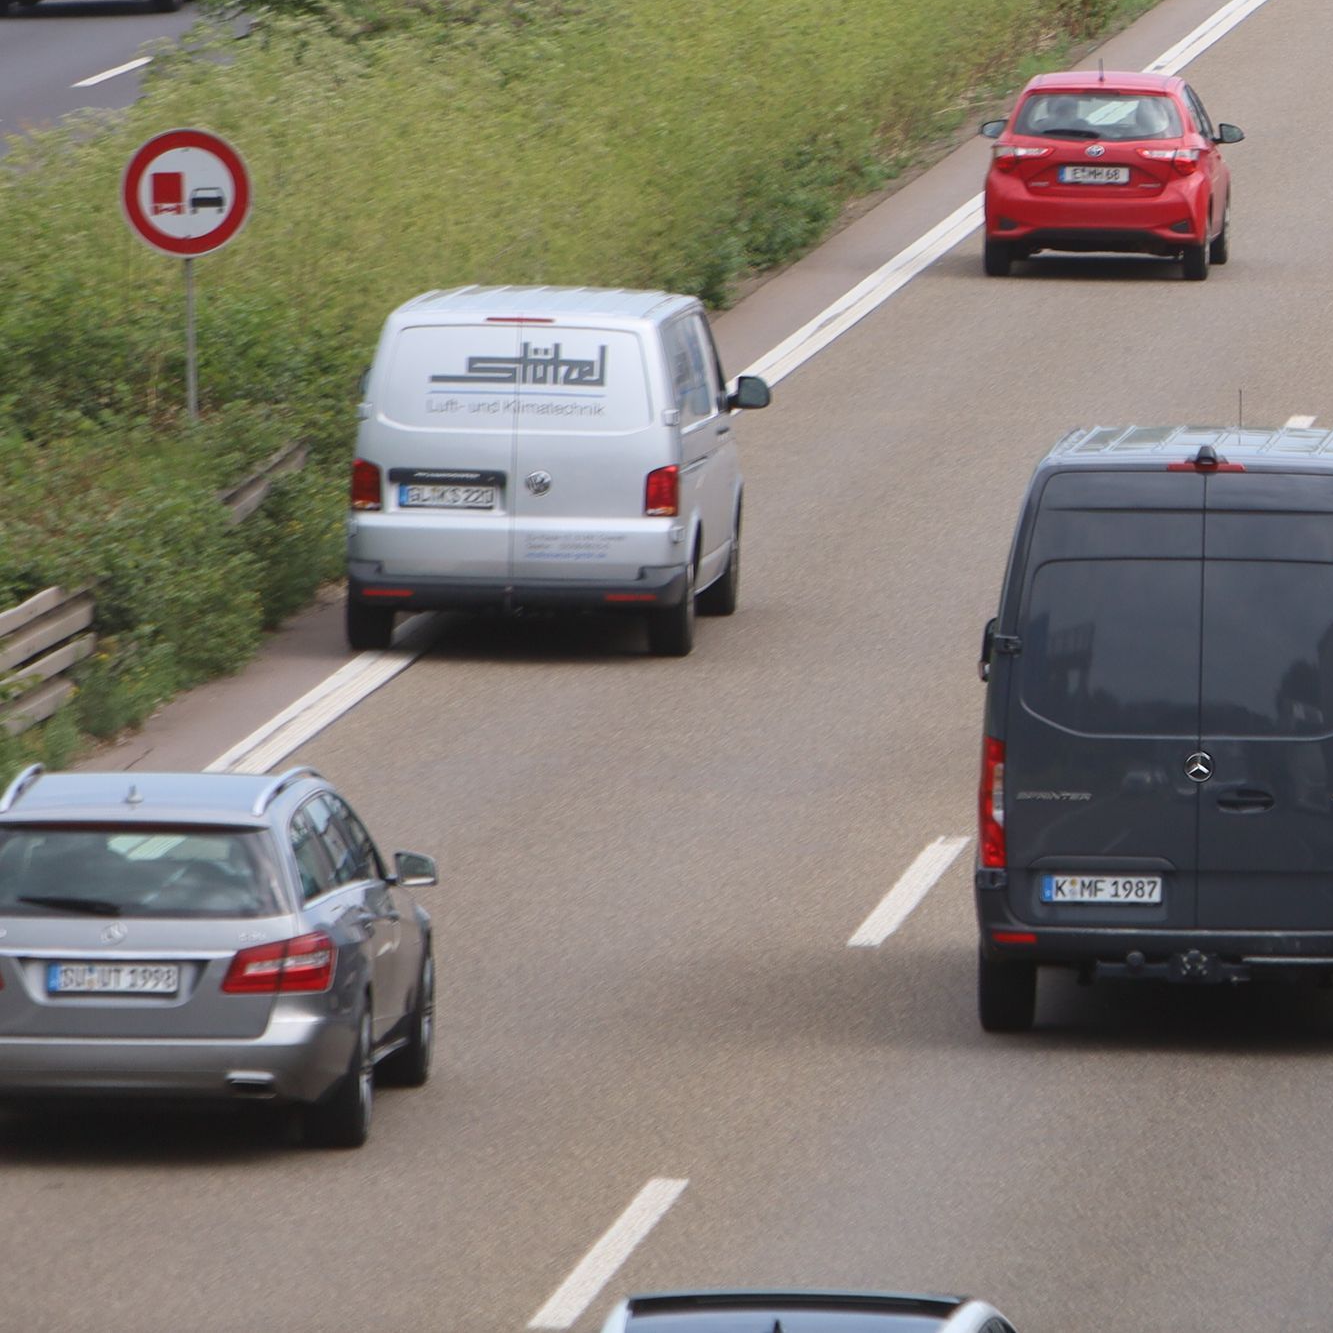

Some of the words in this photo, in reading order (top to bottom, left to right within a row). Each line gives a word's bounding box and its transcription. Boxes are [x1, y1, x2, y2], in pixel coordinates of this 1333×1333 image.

[503, 399, 606, 416] Klimatechnik
[1055, 879, 1068, 898] K
[1080, 879, 1107, 898] MF
[1110, 880, 1158, 899] 1987
